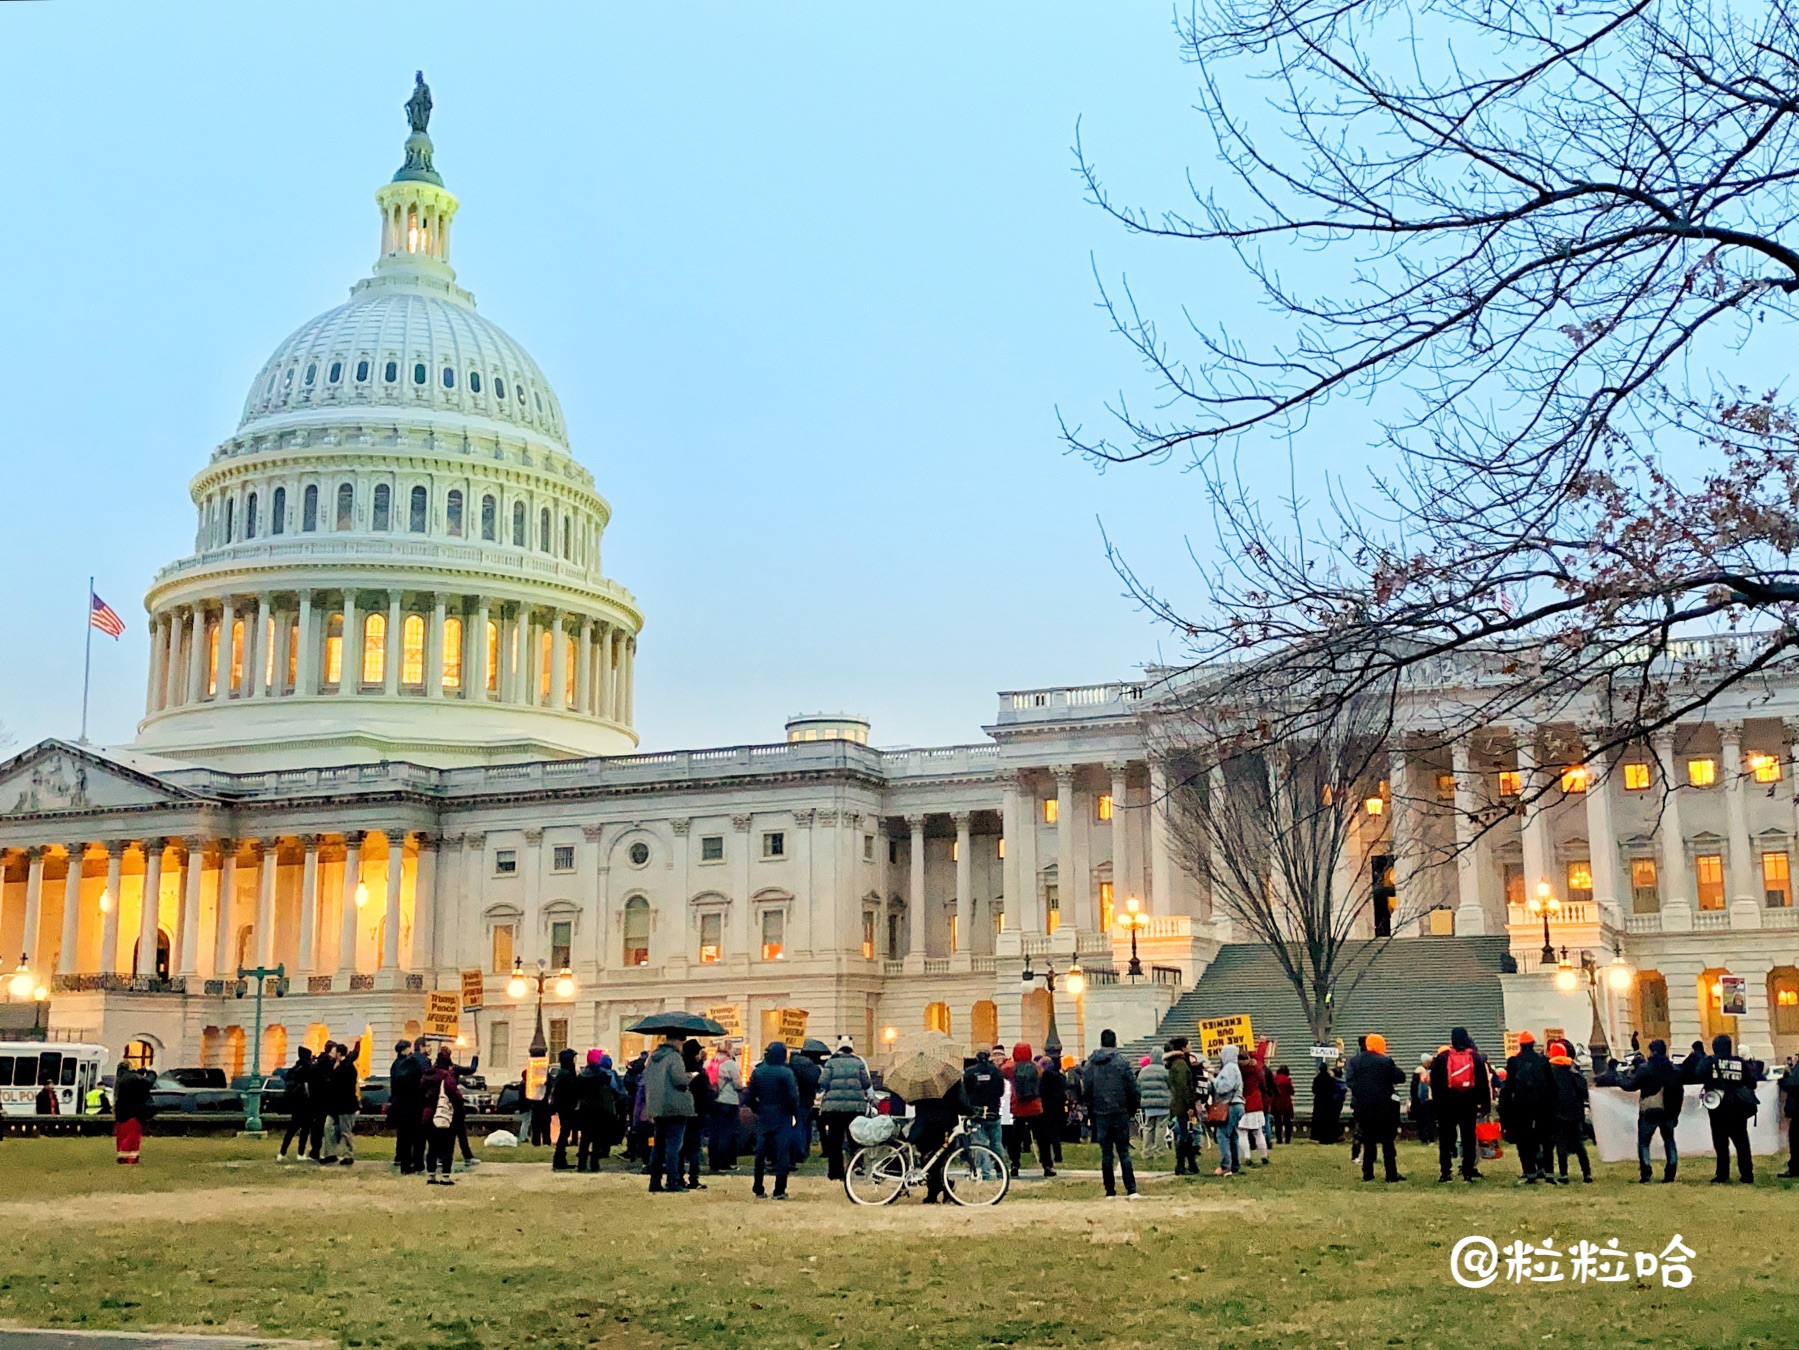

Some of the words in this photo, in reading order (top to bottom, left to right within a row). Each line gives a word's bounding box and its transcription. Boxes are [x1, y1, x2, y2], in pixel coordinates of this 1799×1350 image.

[432, 1003, 456, 1012] Pence
[1202, 1016, 1242, 1030] ENEMIES
[1217, 1028, 1235, 1037] OUR
[1208, 1039, 1224, 1048] NOT
[1227, 1035, 1244, 1045] ARE
